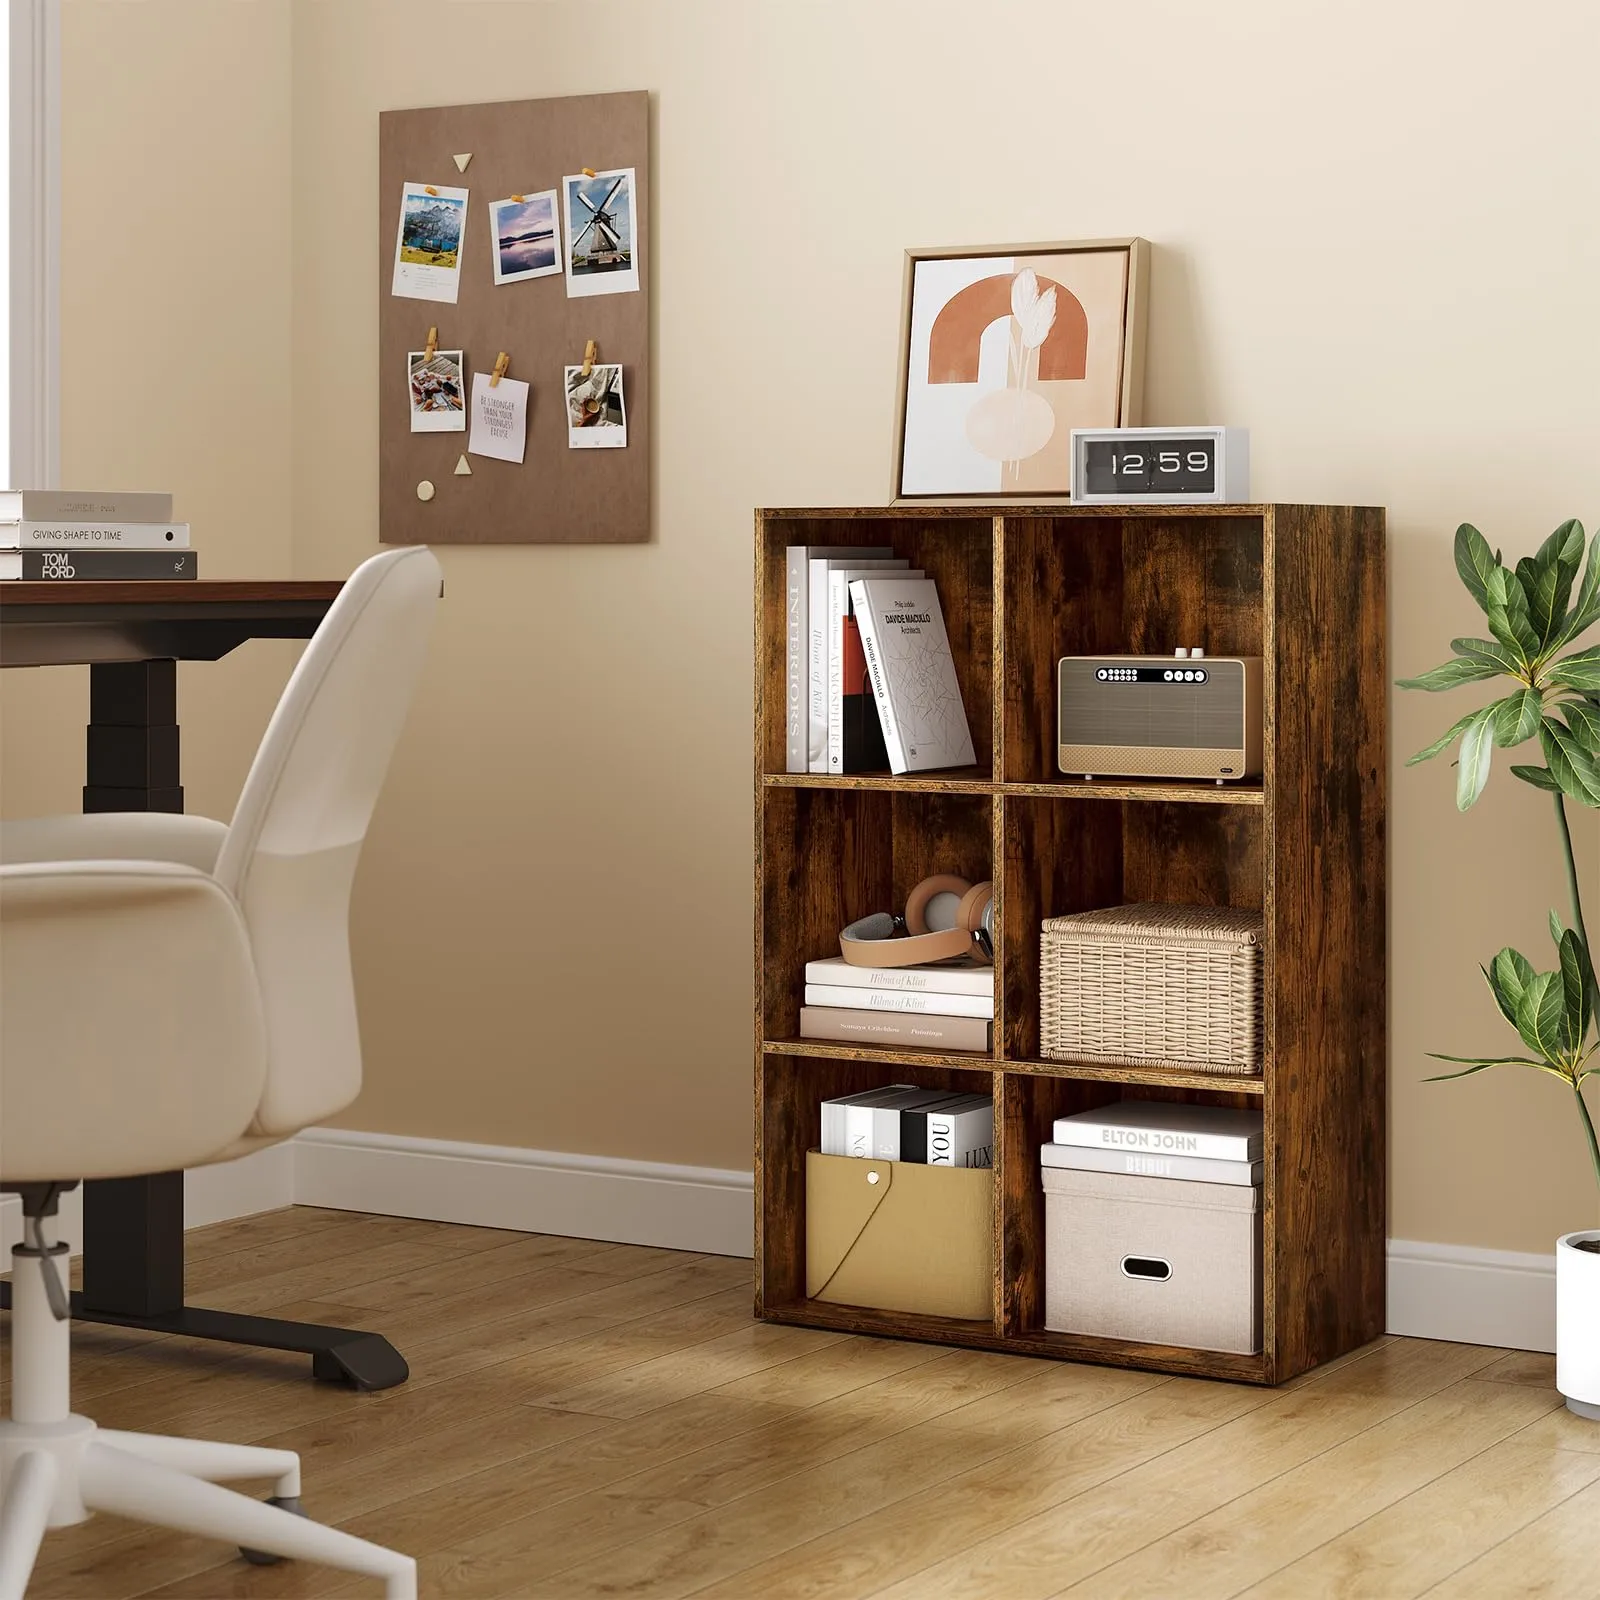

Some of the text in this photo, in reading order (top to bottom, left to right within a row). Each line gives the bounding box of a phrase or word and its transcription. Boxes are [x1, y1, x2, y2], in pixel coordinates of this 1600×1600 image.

[488, 398, 515, 411] STRONGER
[483, 407, 513, 420] THAN YOUR
[32, 530, 122, 541] GIVING SHAPE TO TIME
[42, 553, 68, 566] TOM
[42, 566, 76, 579] FORD
[884, 614, 931, 624] DAVIDE MACULLO
[866, 637, 877, 663] DAVIDE
[790, 586, 801, 737] INTERIORS
[871, 664, 885, 699] MACULLO
[870, 973, 894, 984] Hilma
[906, 976, 927, 987] Klint
[870, 994, 894, 1007] Hilma
[906, 998, 927, 1009] Klint
[932, 1122, 950, 1164] YOU
[1102, 1129, 1197, 1151] ELTON JOHN
[1126, 1156, 1172, 1175] BEIRUT
